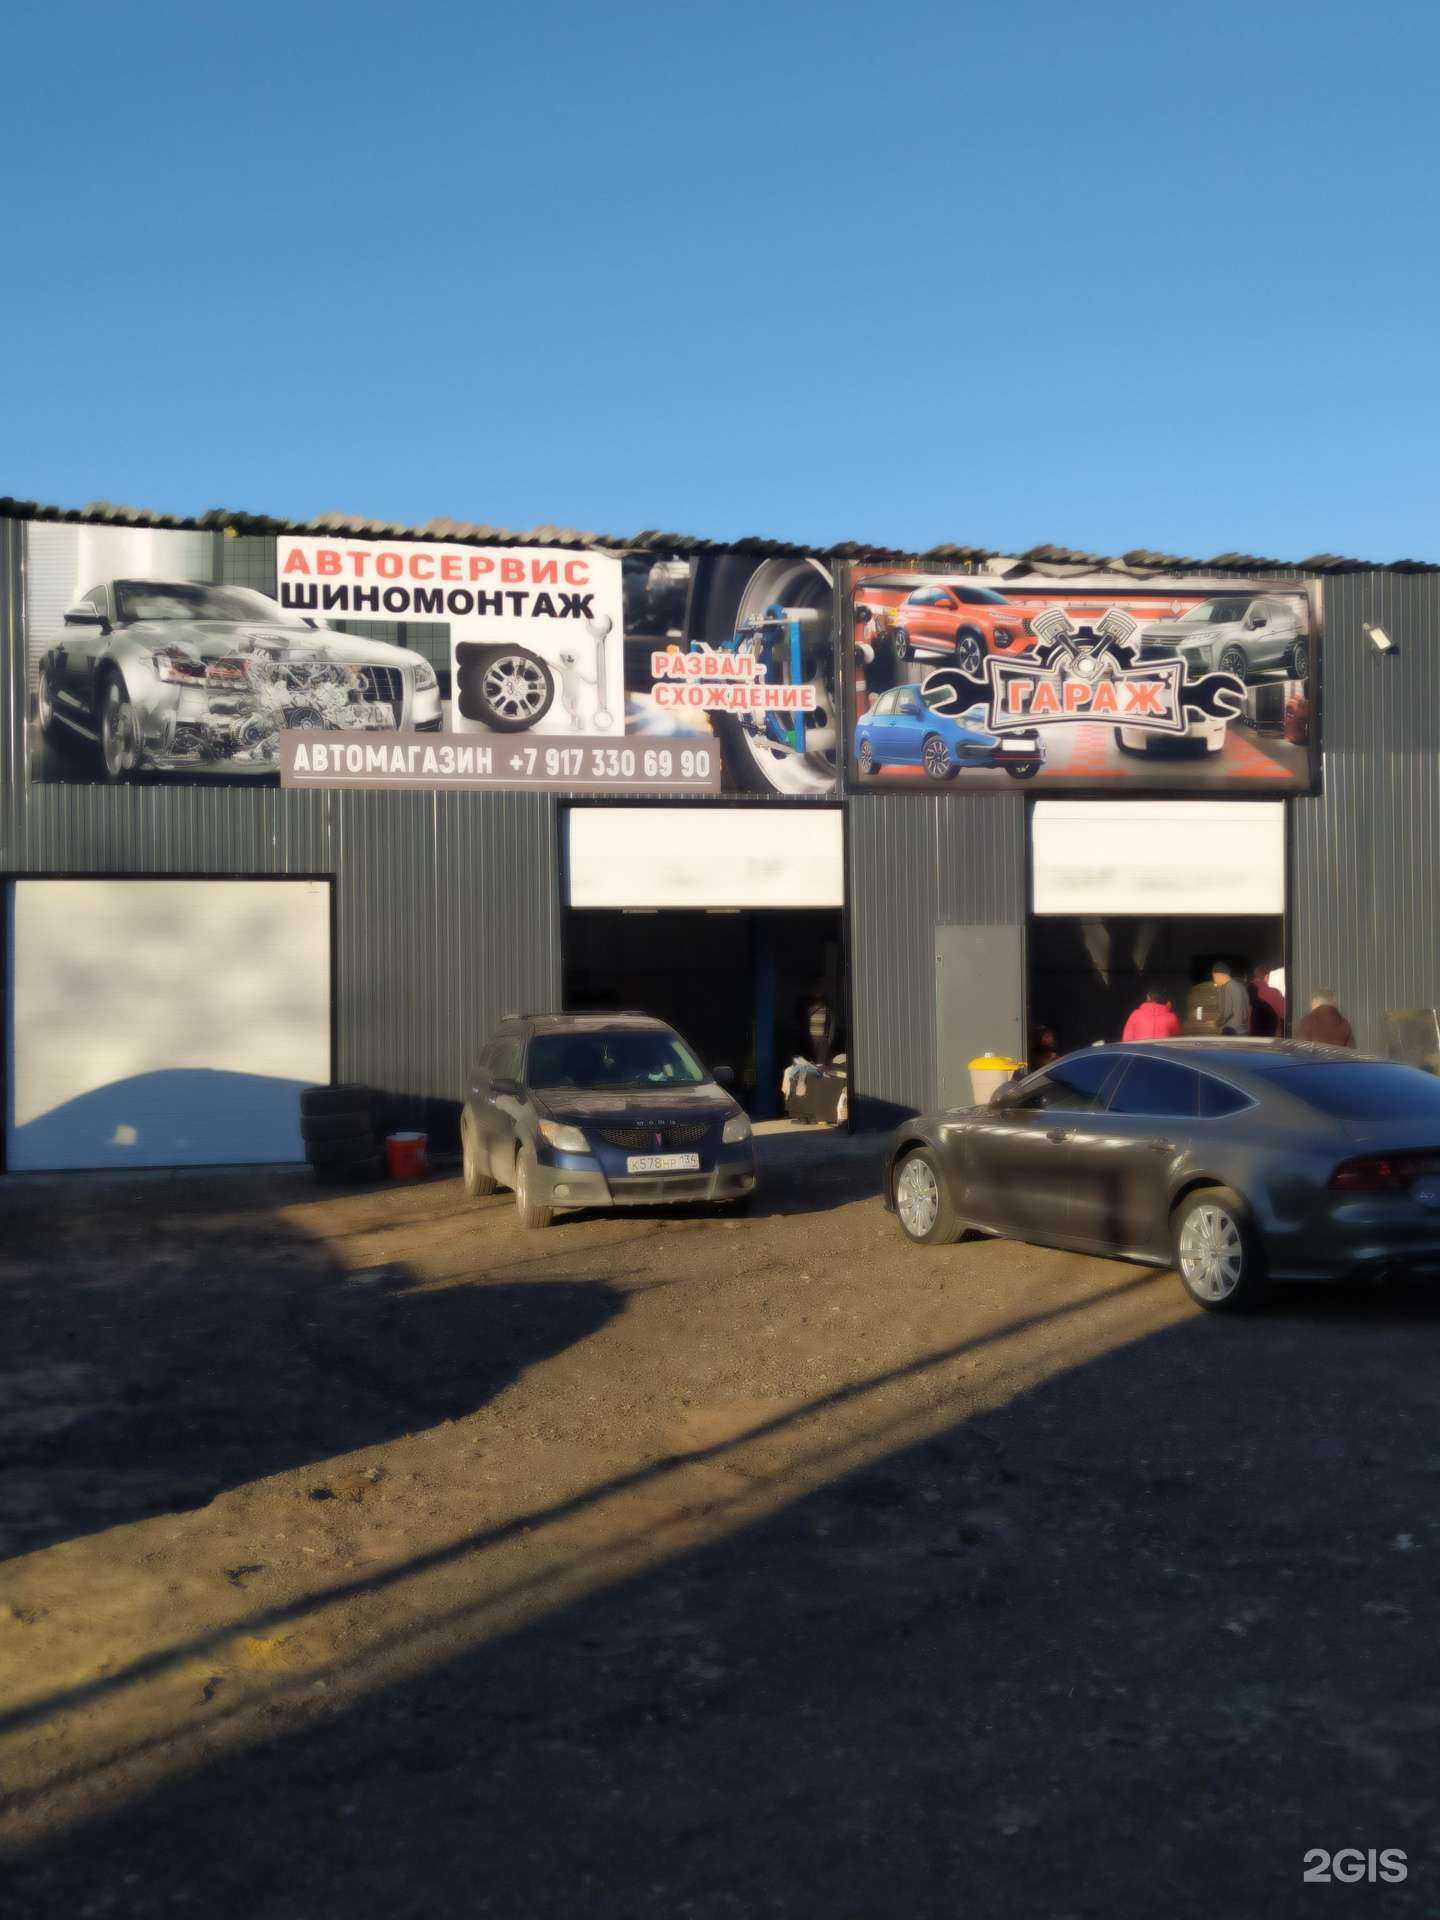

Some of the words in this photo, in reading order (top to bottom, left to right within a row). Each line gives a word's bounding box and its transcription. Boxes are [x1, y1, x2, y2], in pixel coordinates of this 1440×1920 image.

[283, 548, 591, 586] АВТОСЕРВИС
[280, 582, 595, 619] ШИНОМОНТАЖ
[654, 655, 764, 677] РАЗВАЛ-
[654, 686, 815, 709] СХОЖДЕНИЕ
[1008, 680, 1168, 714] ГАРАЖ
[293, 743, 493, 775] АВТОМАГАЗИН
[509, 748, 536, 776] +7
[545, 747, 584, 777] 917
[591, 748, 636, 777] 330
[643, 749, 673, 778] 69
[680, 749, 711, 778] 90
